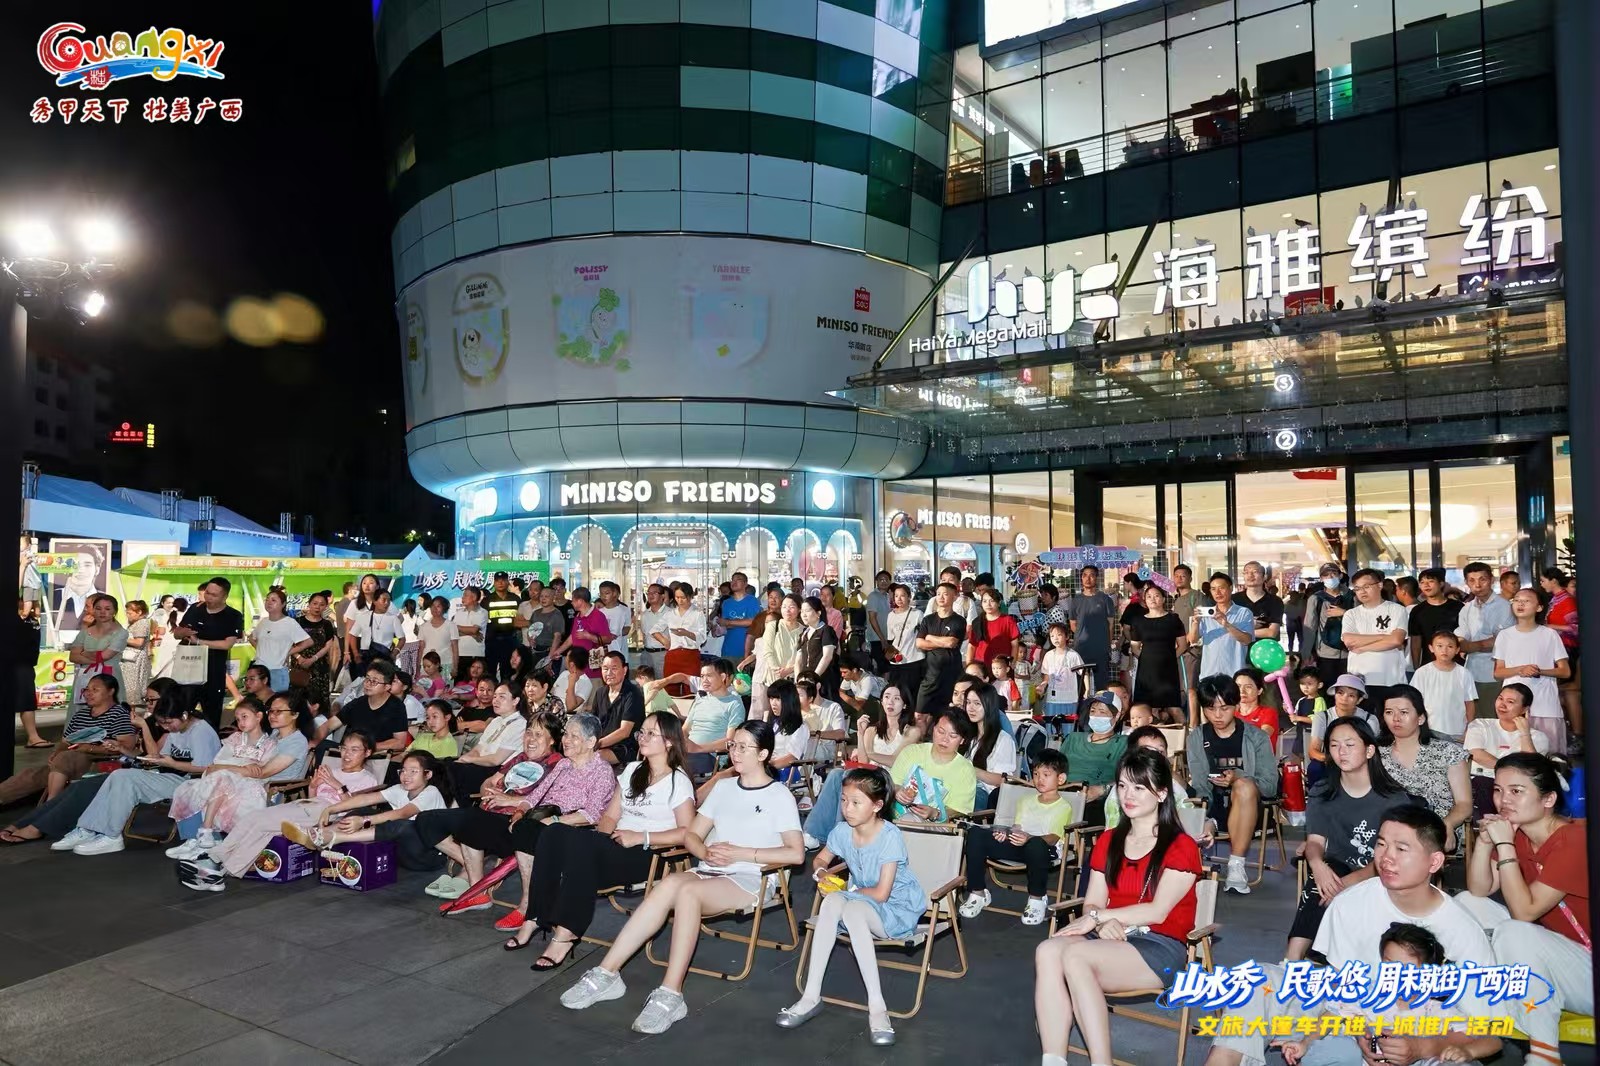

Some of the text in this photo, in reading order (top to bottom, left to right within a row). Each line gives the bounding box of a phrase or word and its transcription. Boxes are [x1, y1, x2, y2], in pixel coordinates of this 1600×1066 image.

[1153, 185, 1549, 315] 海雅缤纷
[817, 316, 858, 333] MINISO
[909, 334, 957, 354] HaiYa
[561, 480, 776, 507] MINISO FRIENDS
[412, 570, 448, 591] 山水秀
[1376, 615, 1391, 629] NY
